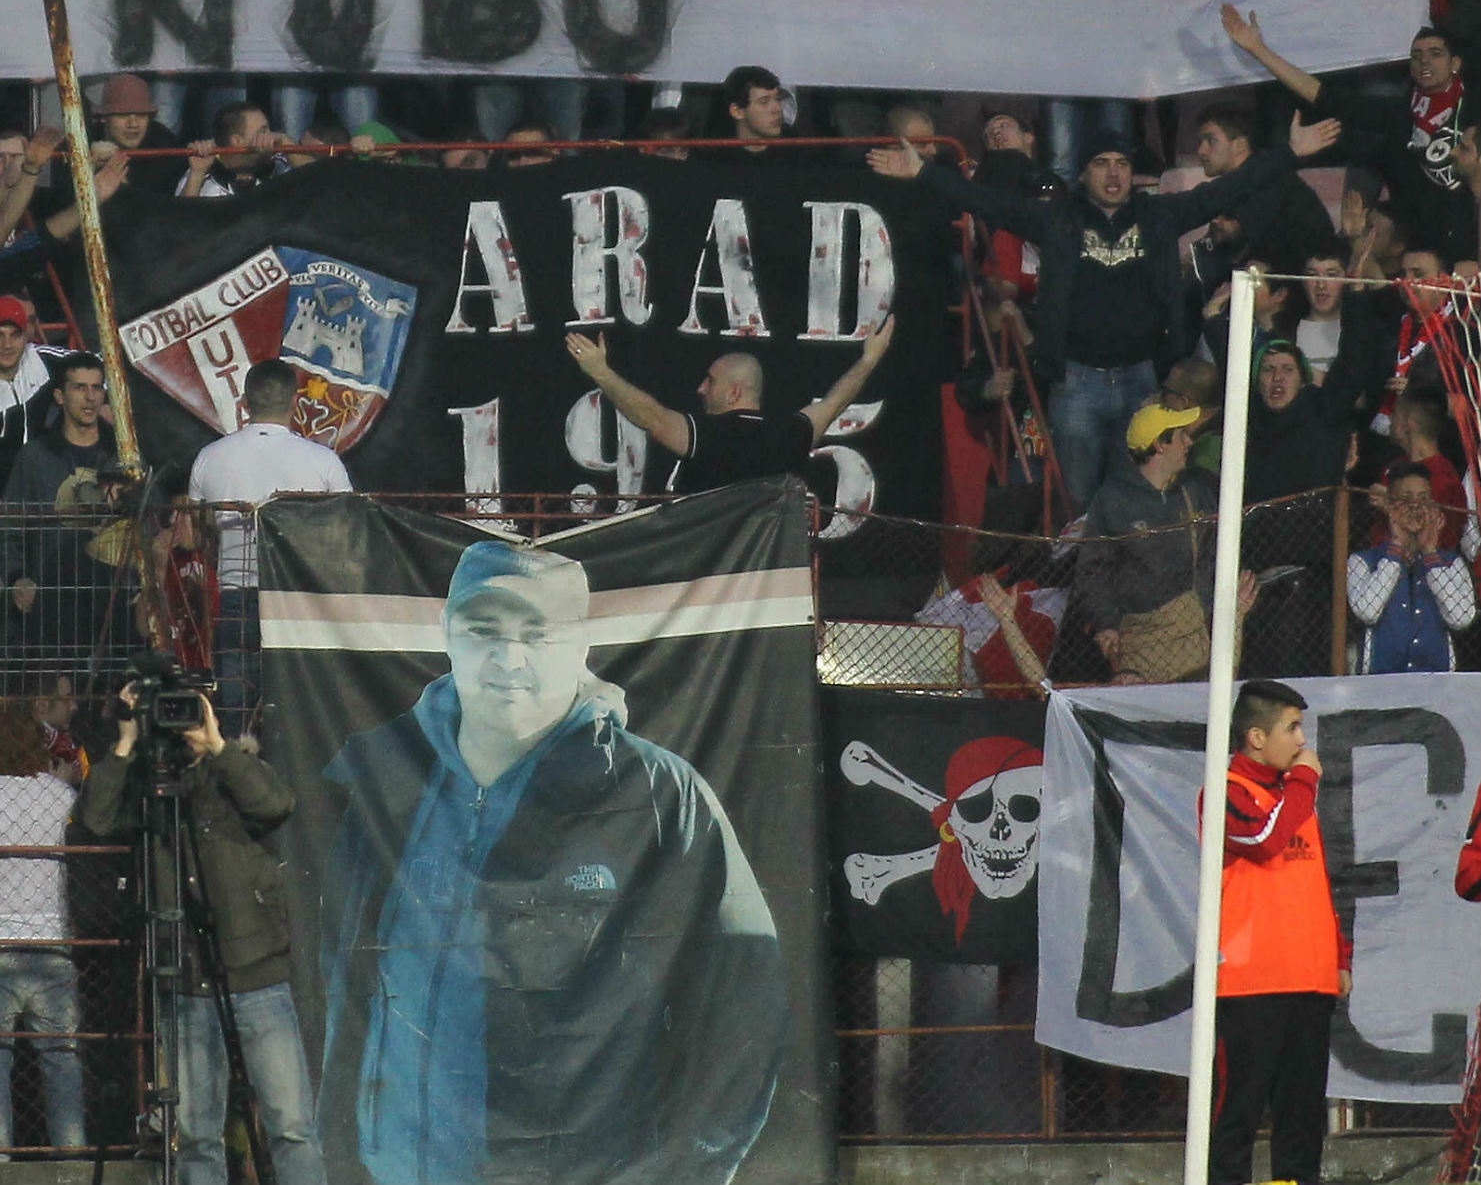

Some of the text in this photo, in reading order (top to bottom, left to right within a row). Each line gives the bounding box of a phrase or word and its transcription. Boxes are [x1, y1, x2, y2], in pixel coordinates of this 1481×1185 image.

[126, 256, 283, 360] FOTBAL CLUB
[444, 185, 897, 343] ARAD
[447, 388, 883, 541] 195
